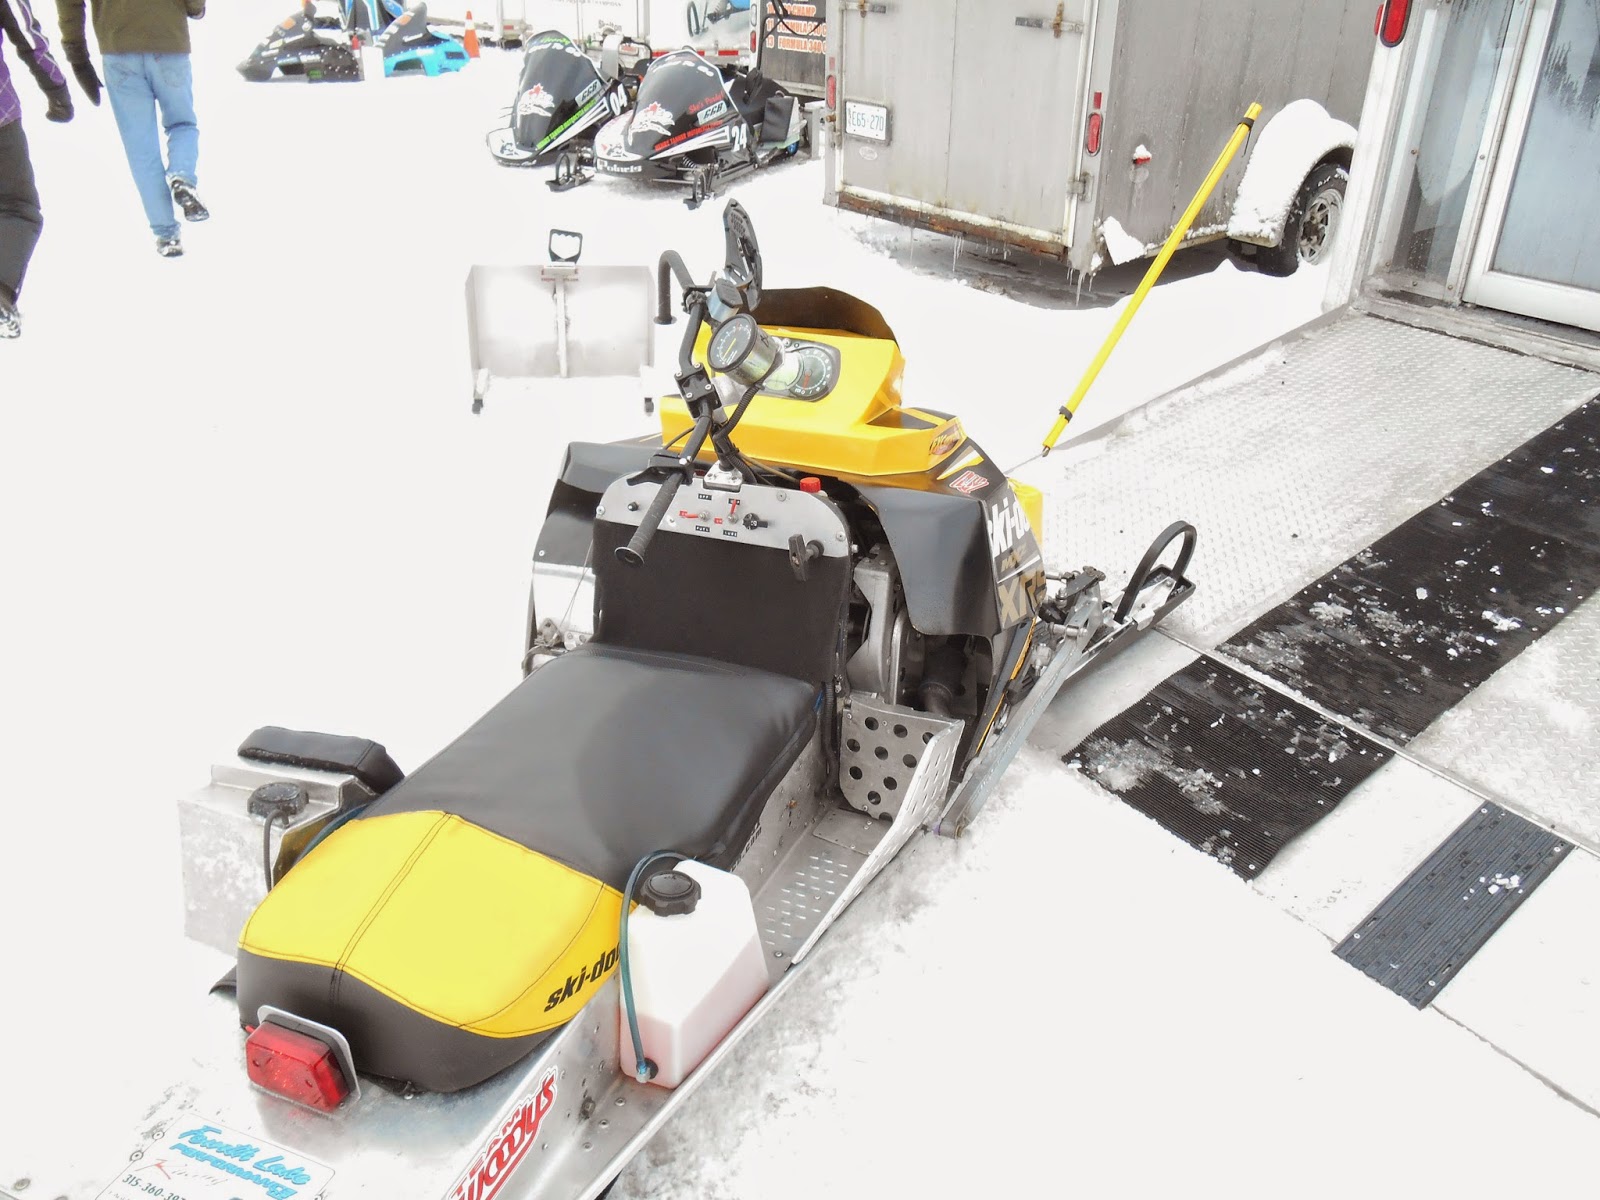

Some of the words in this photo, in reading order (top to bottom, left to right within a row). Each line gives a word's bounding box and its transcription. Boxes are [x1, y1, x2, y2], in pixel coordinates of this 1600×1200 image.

[777, 36, 808, 52] FORMULA
[731, 122, 747, 152] 24
[253, 1155, 312, 1186] Lake
